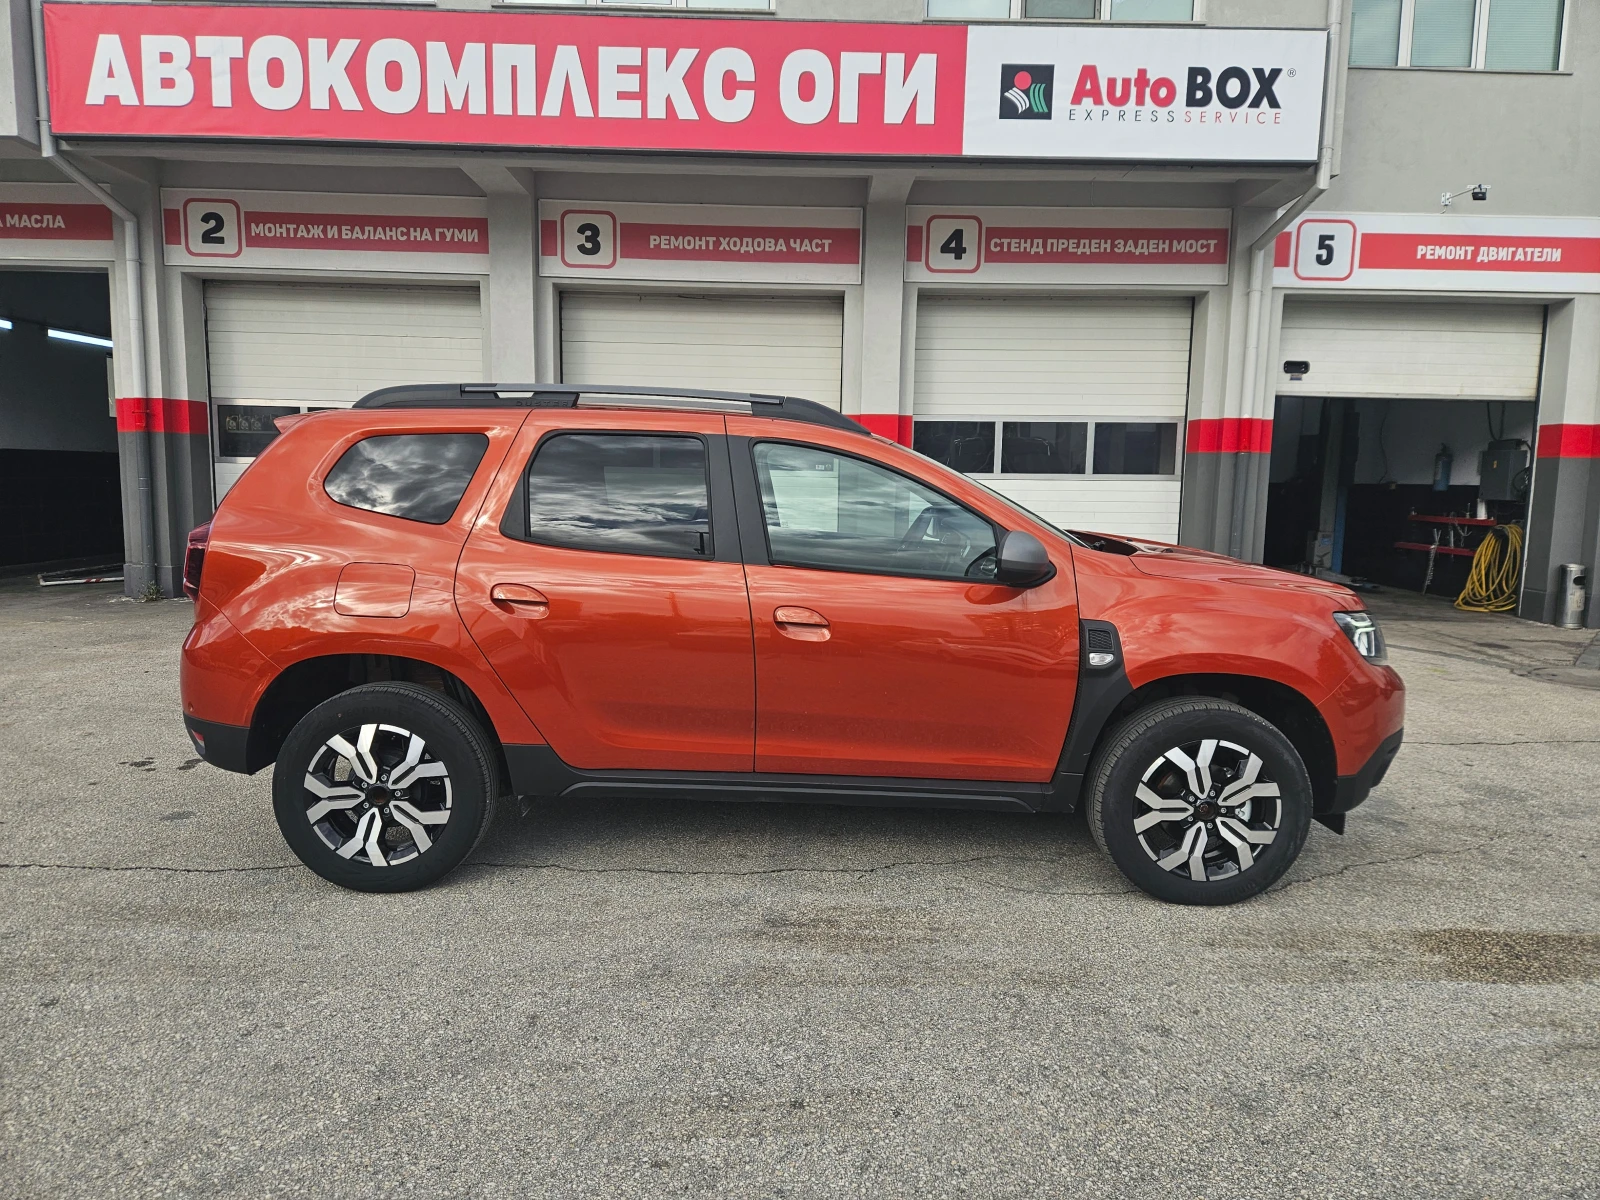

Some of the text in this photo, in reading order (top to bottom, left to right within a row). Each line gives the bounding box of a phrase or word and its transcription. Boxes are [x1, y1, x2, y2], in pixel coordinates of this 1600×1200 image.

[84, 33, 938, 126] АВТОКОМПЛЕКС ОГИ
[1069, 64, 1283, 109] Auto BOX
[1068, 108, 1281, 125] EXPRESS SERVICE
[5, 213, 66, 229] МАСЛА
[200, 211, 226, 245] 2
[251, 223, 479, 242] МОНТАЖ И БАЛАНС НА ГУМИ
[576, 222, 602, 256] 3
[650, 235, 832, 252] РЕМОНТ ХОДОВА ЧАСТ
[939, 228, 967, 261] 4
[990, 238, 1218, 254] СТЕНД ПРЕДЕН ЗАДЕН МОСТ
[1315, 234, 1336, 267] 5
[1416, 245, 1562, 262] РЕМОНТ ДВИГАТЕЛИ
